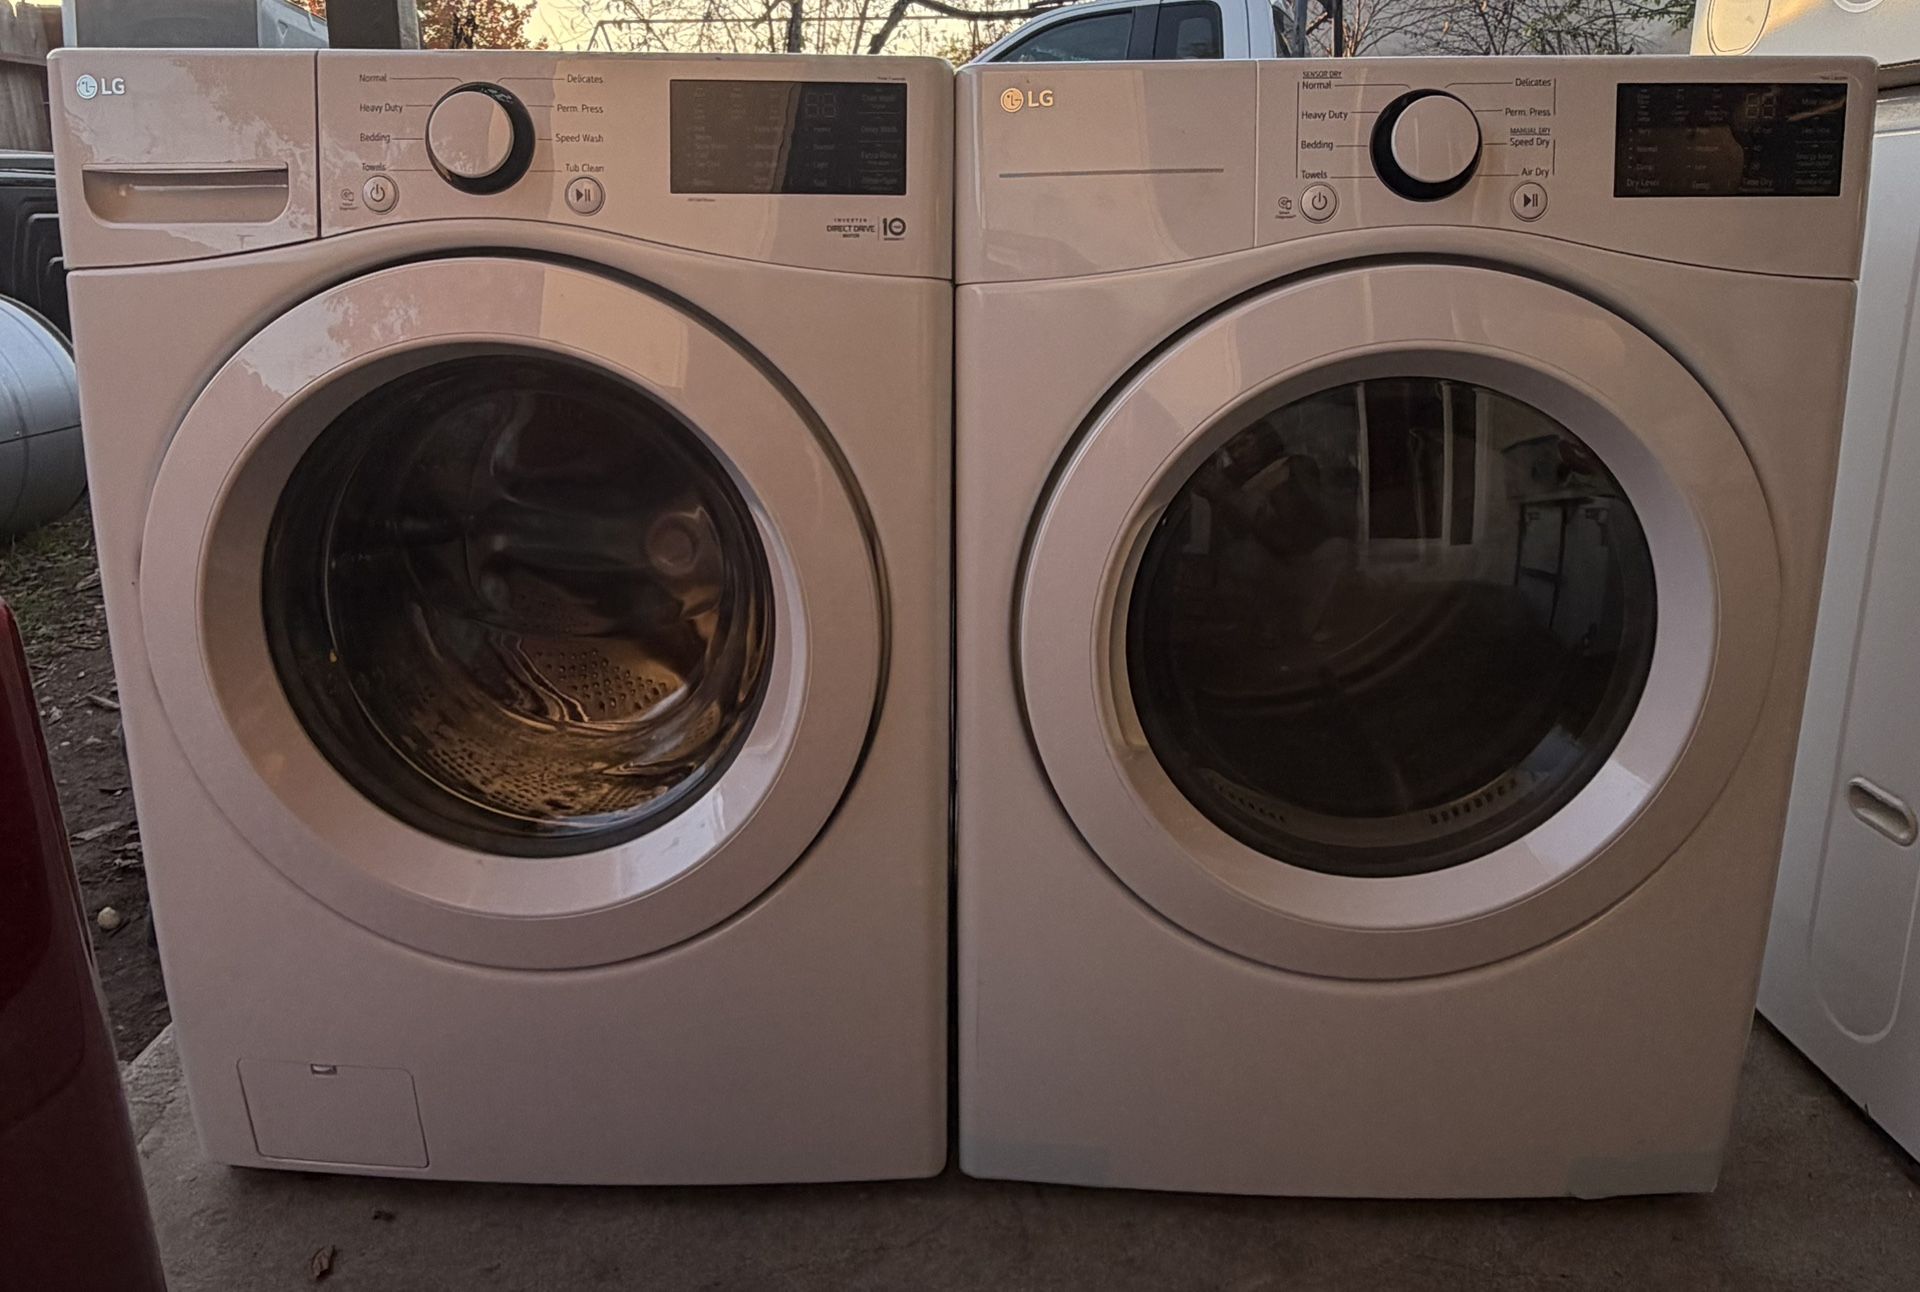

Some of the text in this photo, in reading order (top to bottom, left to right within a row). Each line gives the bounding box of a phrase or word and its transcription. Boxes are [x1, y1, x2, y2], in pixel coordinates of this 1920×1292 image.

[359, 74, 388, 83] Normal
[567, 74, 604, 84] Delicates
[1515, 78, 1552, 87] Delicates
[101, 77, 126, 95] LG
[1302, 81, 1332, 90] Normal
[1027, 89, 1054, 107] LG
[359, 103, 403, 114] Heavy Duty
[556, 104, 604, 114] Perm. Press
[1505, 108, 1551, 117] Perm. Press
[1301, 110, 1349, 121] Heavy Duty
[359, 133, 391, 144] Bedding
[555, 133, 604, 144] Speed Wash
[1510, 137, 1550, 149] Speed Dry
[1301, 140, 1334, 151] Bedding
[361, 162, 386, 171] Towels
[565, 163, 605, 173] Tub Clean
[1301, 170, 1328, 179] Towels
[1521, 167, 1550, 178] Air Dry
[826, 224, 876, 233] DIRECT DRIVE
[882, 217, 907, 236] 10
